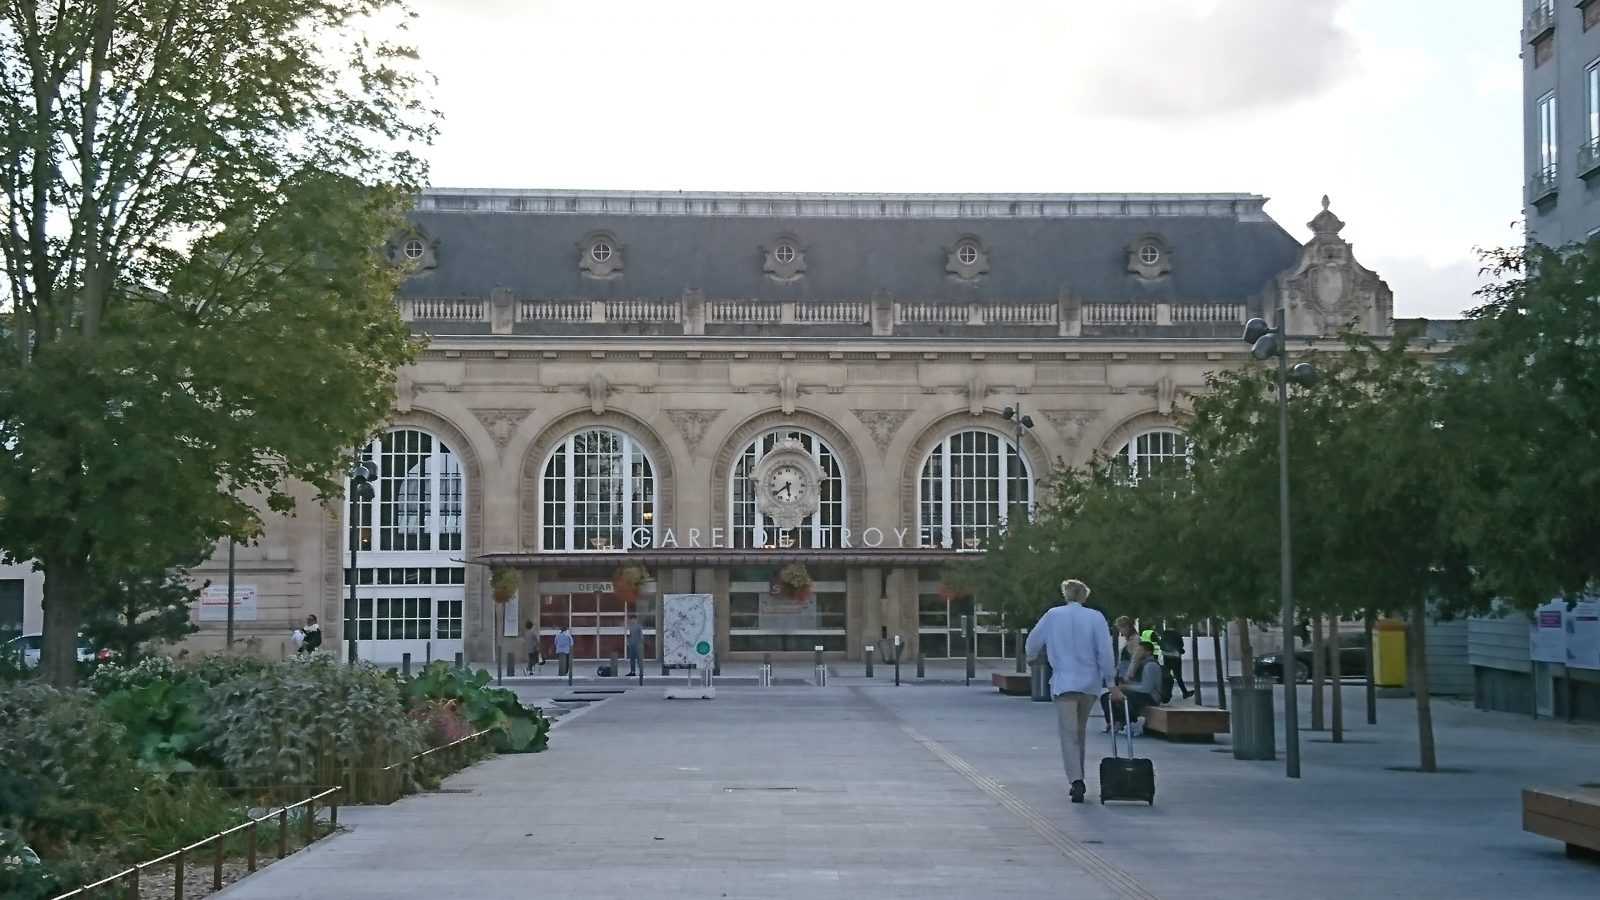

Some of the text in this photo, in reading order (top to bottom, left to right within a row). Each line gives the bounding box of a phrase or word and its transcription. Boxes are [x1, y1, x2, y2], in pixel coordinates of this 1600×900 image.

[631, 528, 953, 548] GARE DE TROYES
[578, 583, 615, 592] DEPAR
